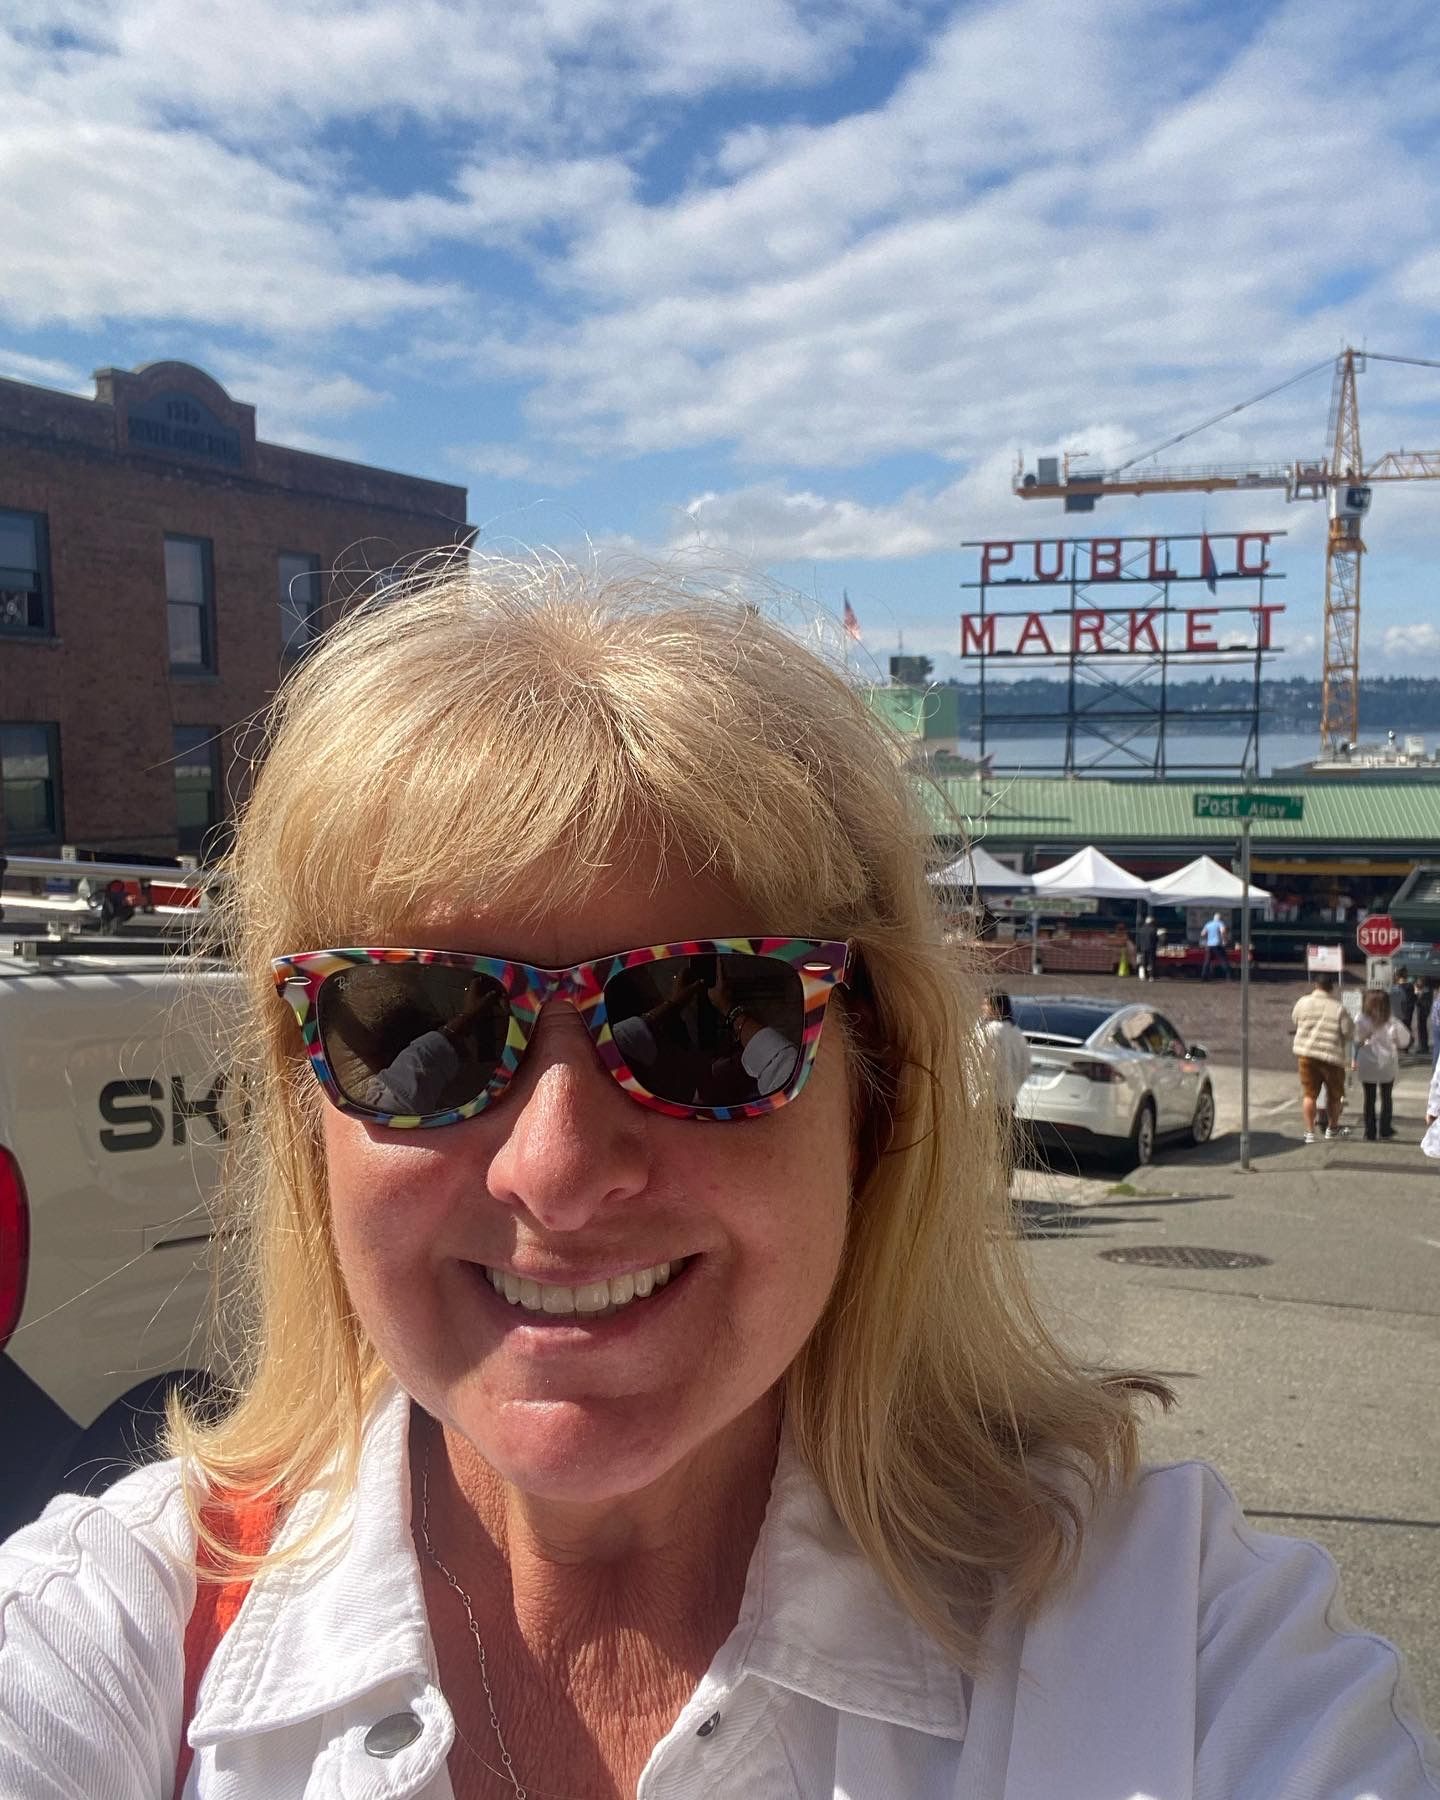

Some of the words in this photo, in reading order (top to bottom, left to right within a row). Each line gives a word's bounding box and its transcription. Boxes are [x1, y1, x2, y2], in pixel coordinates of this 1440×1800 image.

[981, 532, 1271, 583] PUBLIC
[961, 604, 1286, 656] MARKET
[1197, 796, 1239, 816] Post
[1248, 801, 1286, 818] Alley
[1359, 928, 1398, 946] STOP
[99, 1072, 252, 1152] SK
